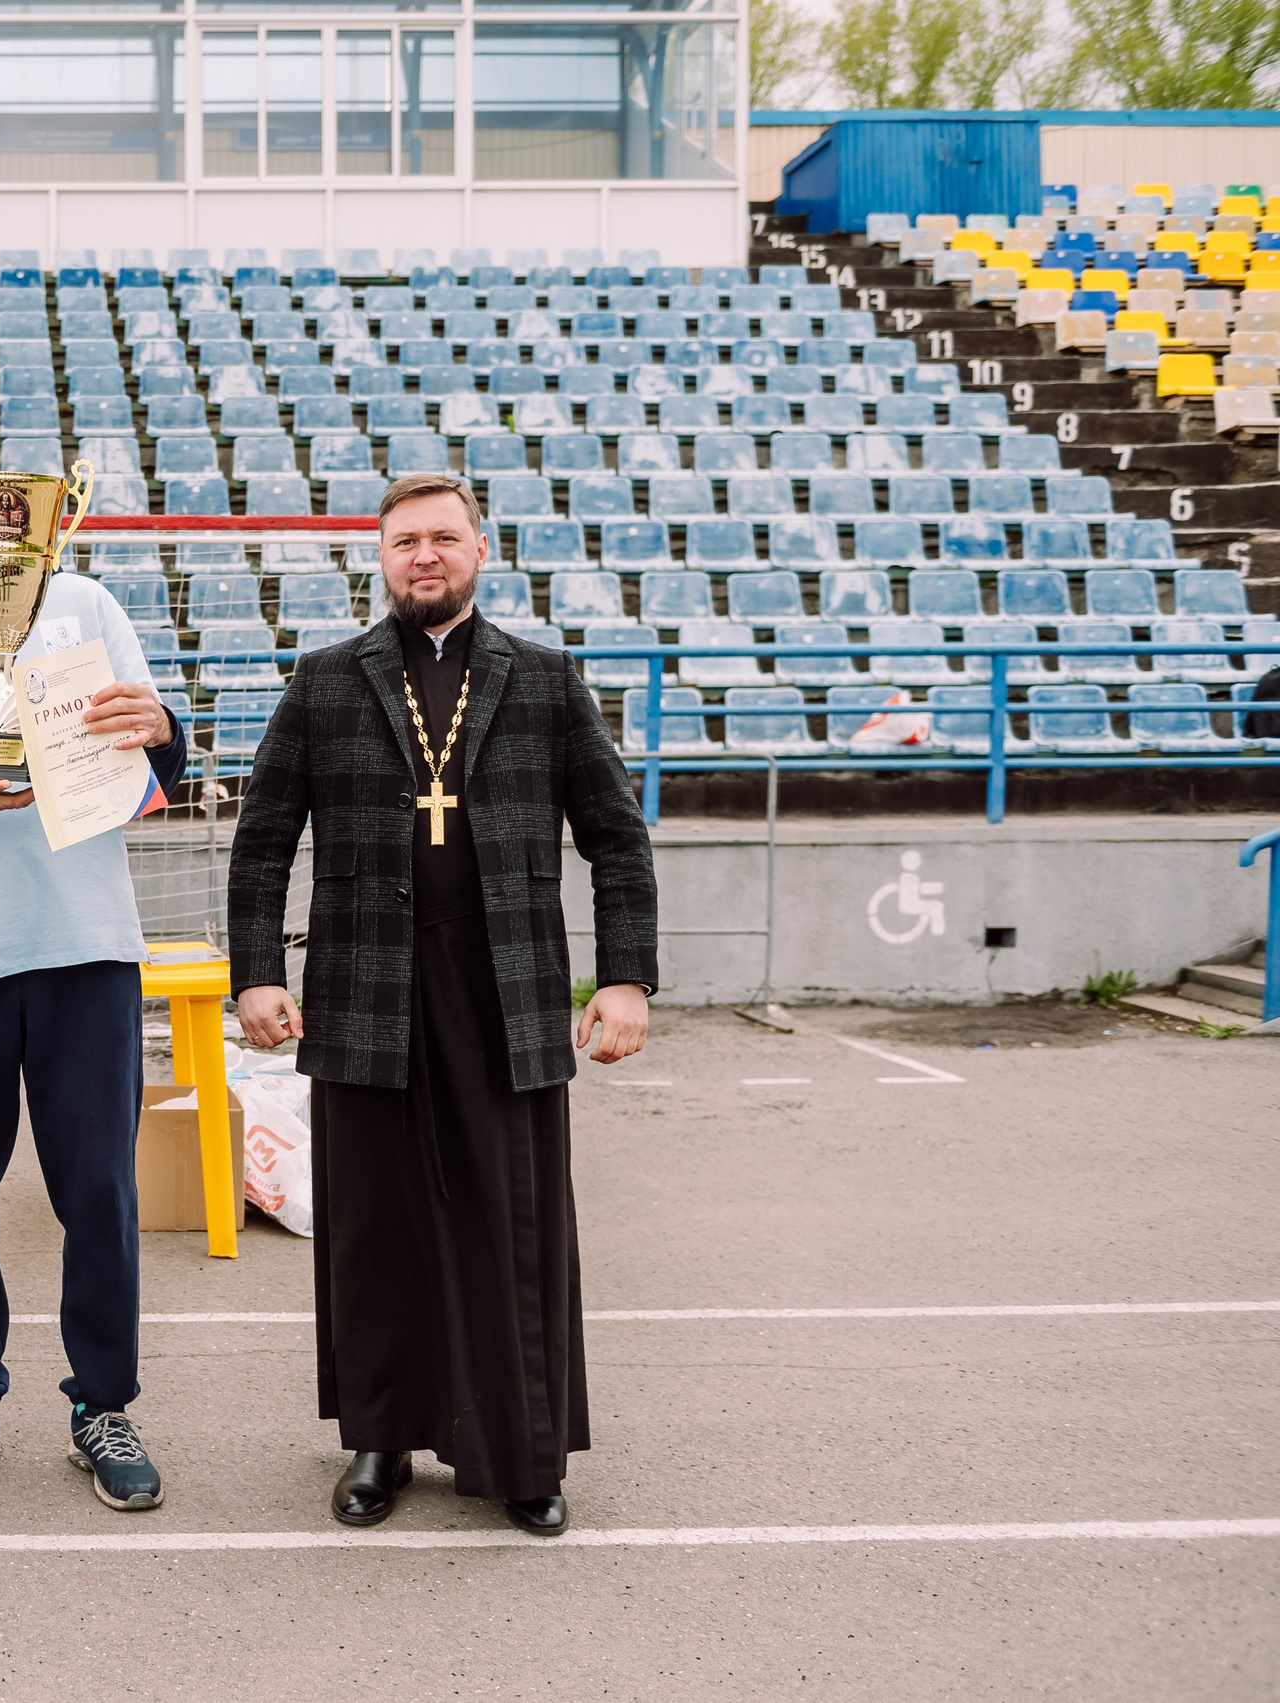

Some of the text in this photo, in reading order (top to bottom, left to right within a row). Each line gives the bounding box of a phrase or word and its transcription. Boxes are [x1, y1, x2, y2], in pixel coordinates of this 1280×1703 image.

[751, 213, 767, 235] 7
[767, 233, 797, 249] 16
[797, 244, 828, 269] 15
[825, 264, 856, 289] 14
[855, 287, 887, 311] 13
[891, 308, 922, 332] 12
[926, 330, 954, 359] 11
[967, 360, 1002, 385] 10
[1012, 382, 1035, 412] 9
[1056, 412, 1080, 443] 8
[1111, 444, 1133, 471] 7
[1170, 487, 1195, 522] 6
[1227, 541, 1252, 578] 5
[244, 1167, 280, 1192] тавка
